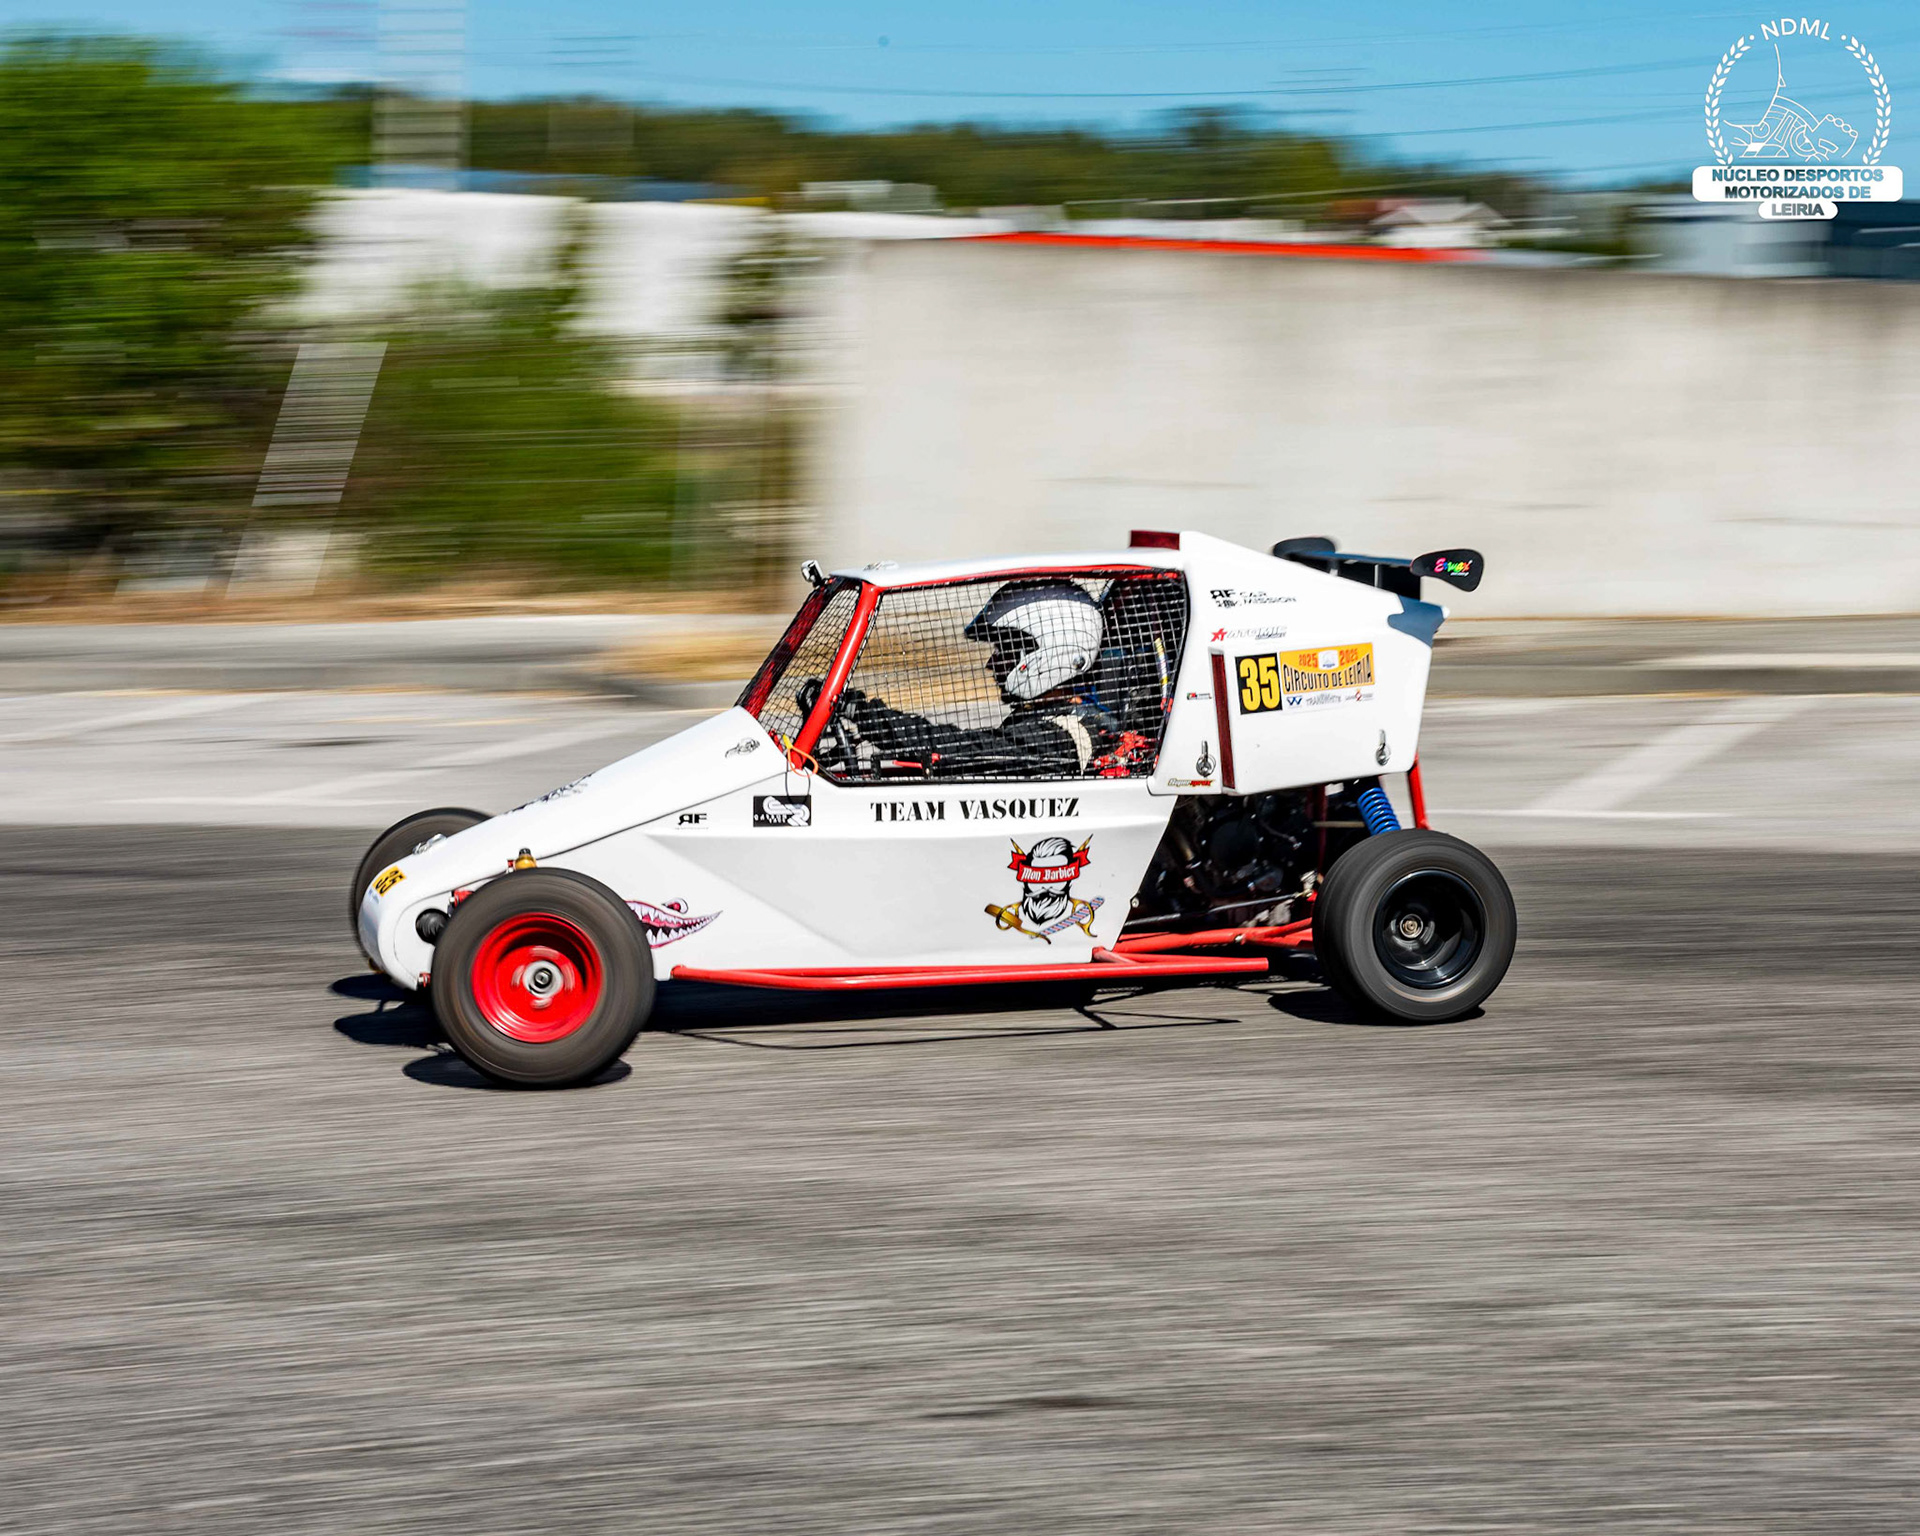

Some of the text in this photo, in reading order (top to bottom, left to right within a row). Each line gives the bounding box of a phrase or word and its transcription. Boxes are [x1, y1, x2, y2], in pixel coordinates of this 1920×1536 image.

[1298, 653, 1318, 668] 2025
[1339, 648, 1359, 666] 2025
[1283, 653, 1373, 692] CIRCUITO DE LEIRIA
[1239, 656, 1281, 711] 35
[870, 797, 1080, 822] TEAM VASQUEZ
[1021, 866, 1076, 881] Mon Barbier
